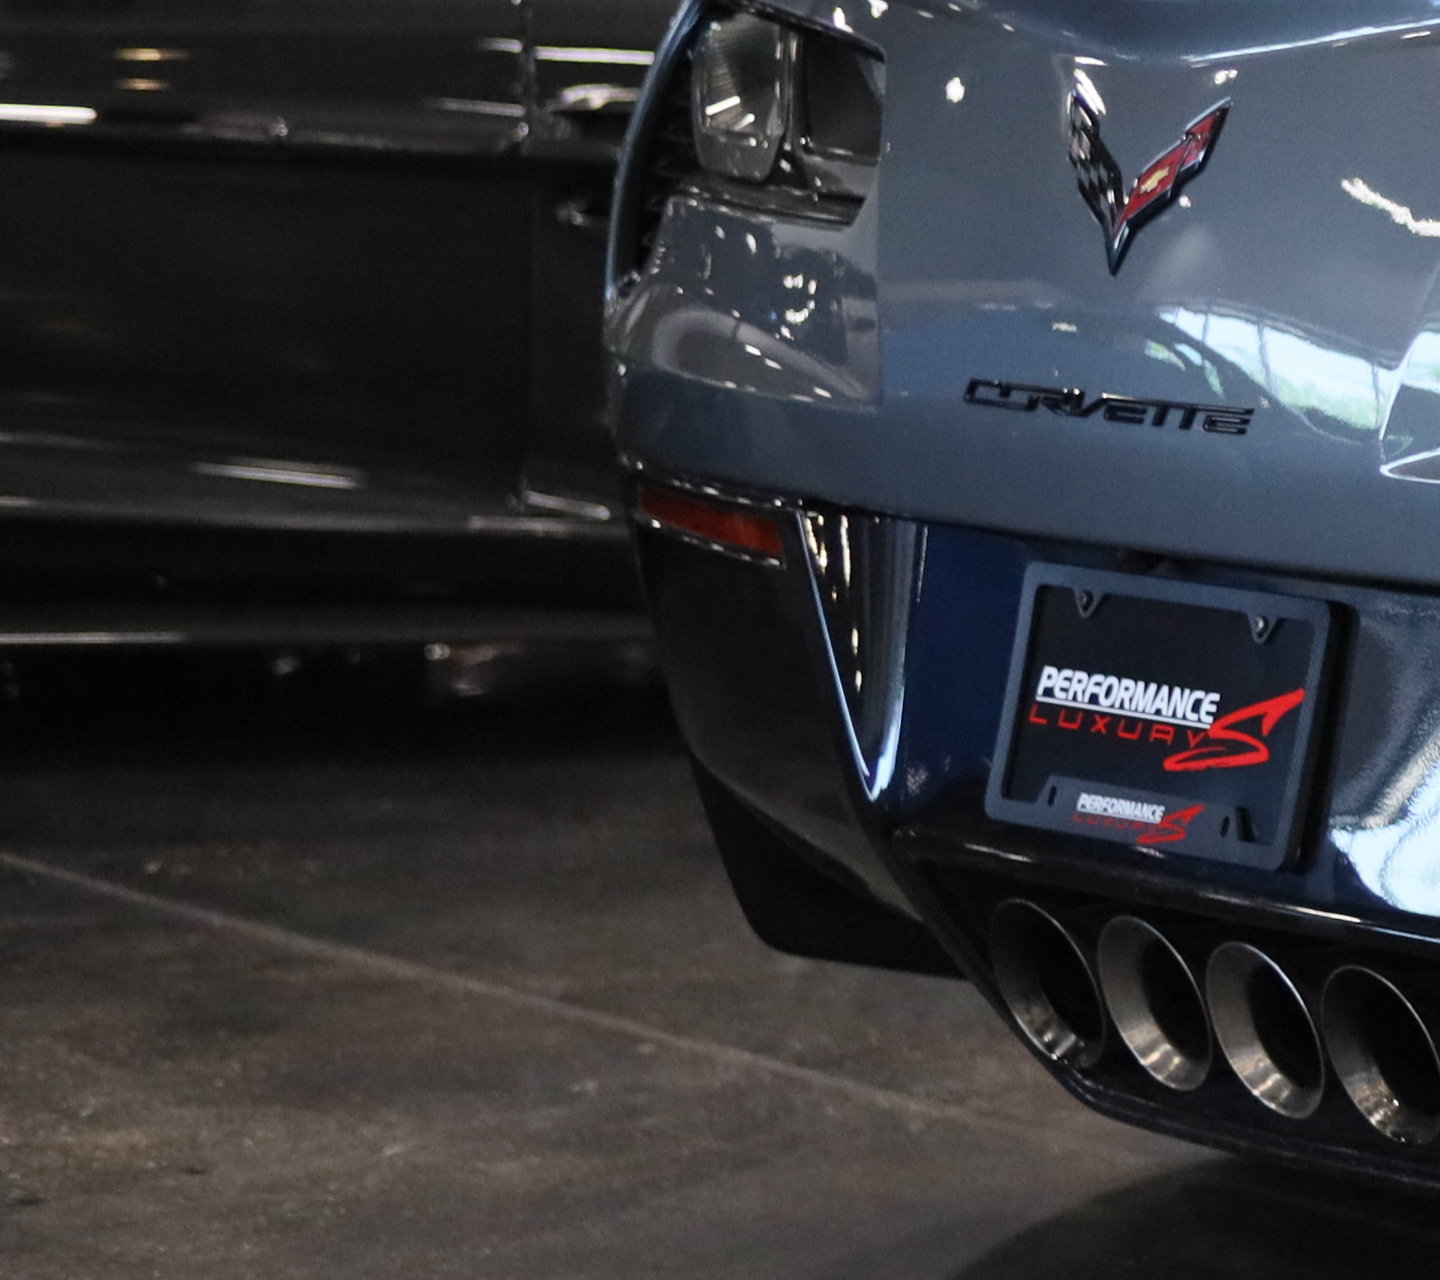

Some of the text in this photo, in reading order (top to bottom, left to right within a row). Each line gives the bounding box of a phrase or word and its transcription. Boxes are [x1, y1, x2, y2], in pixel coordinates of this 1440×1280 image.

[963, 377, 1255, 435] CORVETTE
[1036, 665, 1221, 725] PERFORMANCE
[1029, 703, 1209, 748] LUXURY
[1076, 792, 1166, 823] PERFORMANCE
